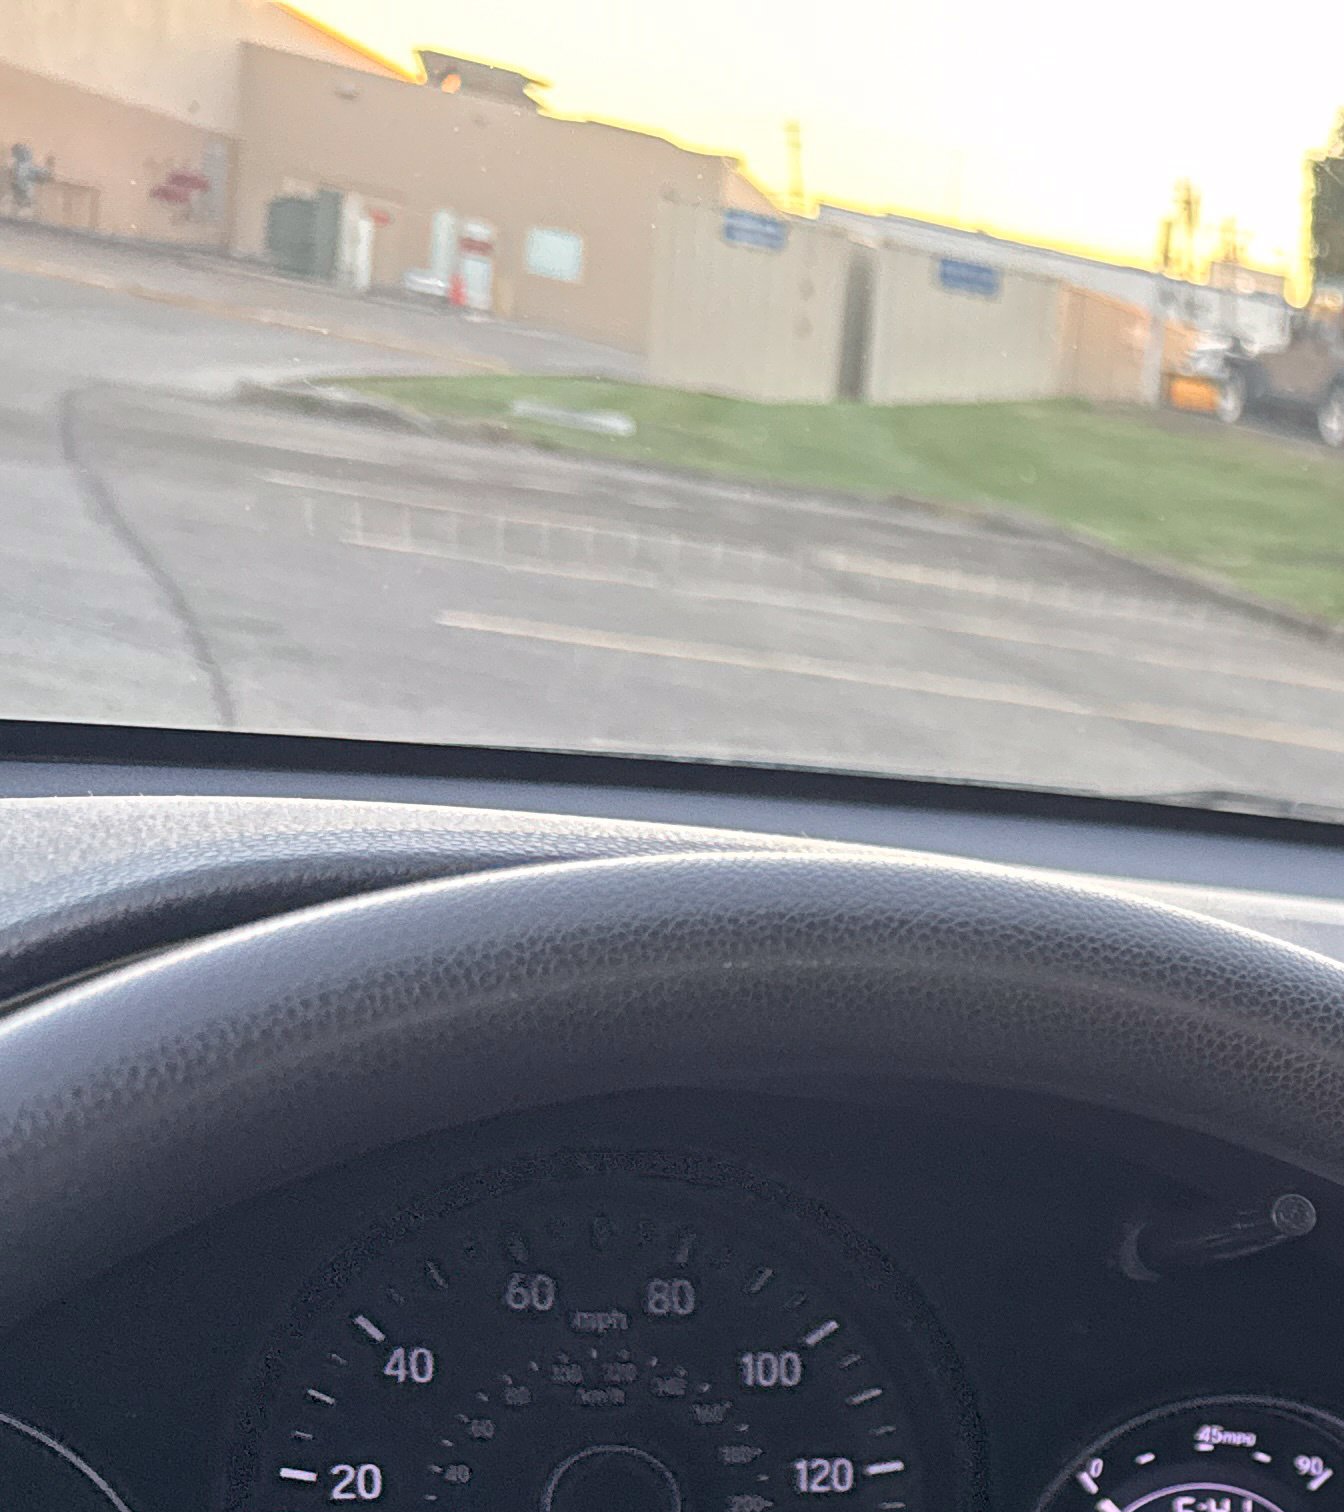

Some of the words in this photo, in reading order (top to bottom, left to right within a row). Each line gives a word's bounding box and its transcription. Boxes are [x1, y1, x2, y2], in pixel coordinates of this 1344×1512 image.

[506, 1273, 554, 1311] 60
[647, 1277, 696, 1315] 80
[384, 1347, 434, 1383] 40
[741, 1350, 801, 1387] 100
[331, 1462, 382, 1499] 20
[796, 1456, 853, 1493] 120
[1295, 1454, 1324, 1477] 90
